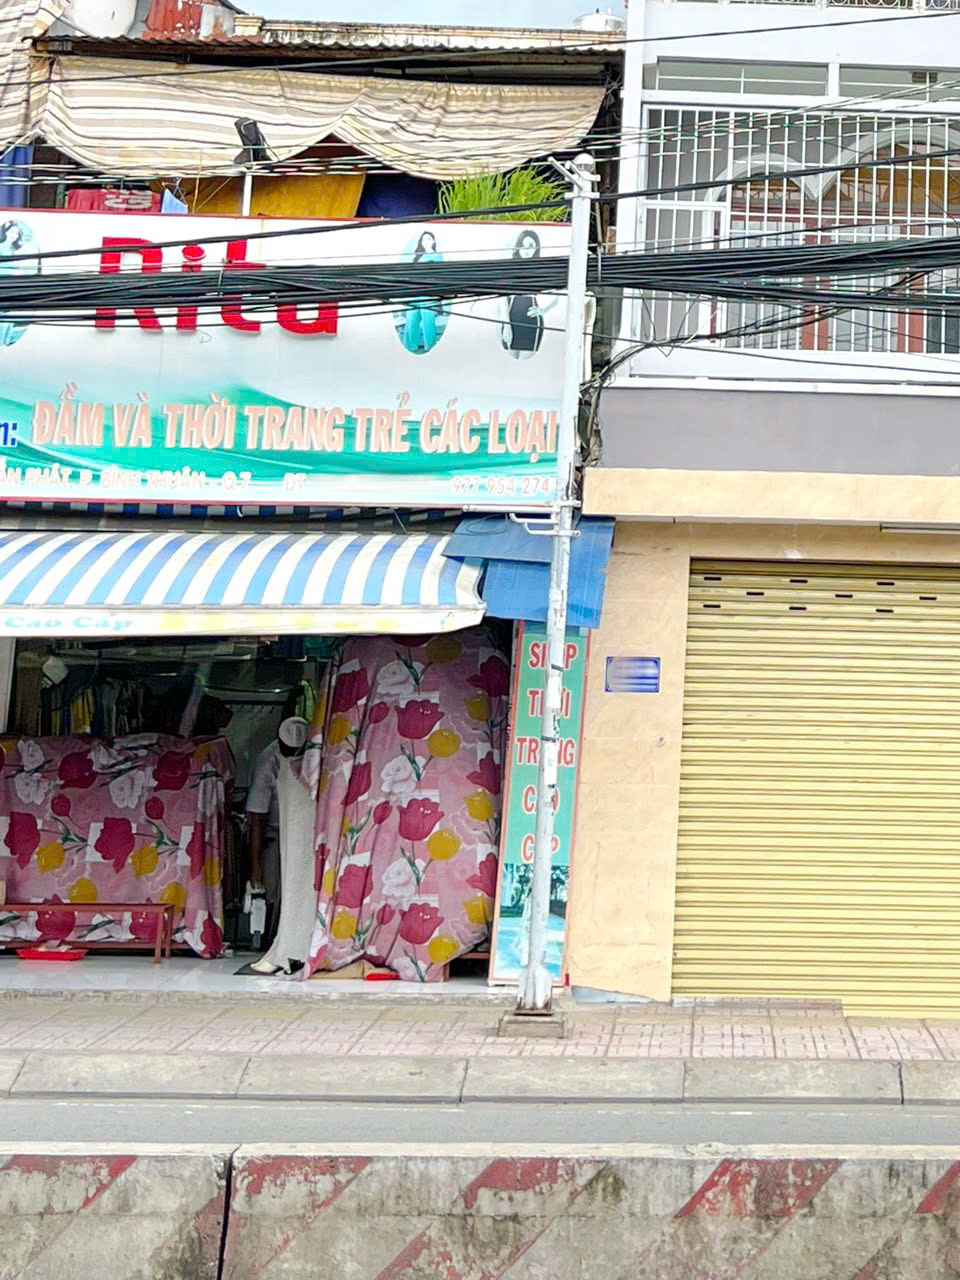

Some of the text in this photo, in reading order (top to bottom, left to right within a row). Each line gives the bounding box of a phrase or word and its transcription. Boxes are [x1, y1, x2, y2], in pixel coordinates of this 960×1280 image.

[31, 381, 105, 446] ĐẦM
[112, 392, 152, 448] VÀ
[162, 391, 236, 450] THỜI
[243, 406, 345, 452] TRANG
[354, 391, 413, 454] TRẺ
[419, 397, 481, 455] CÁC
[487, 408, 558, 464] LOẠI
[528, 641, 577, 670] SP
[516, 737, 575, 766] TRG
